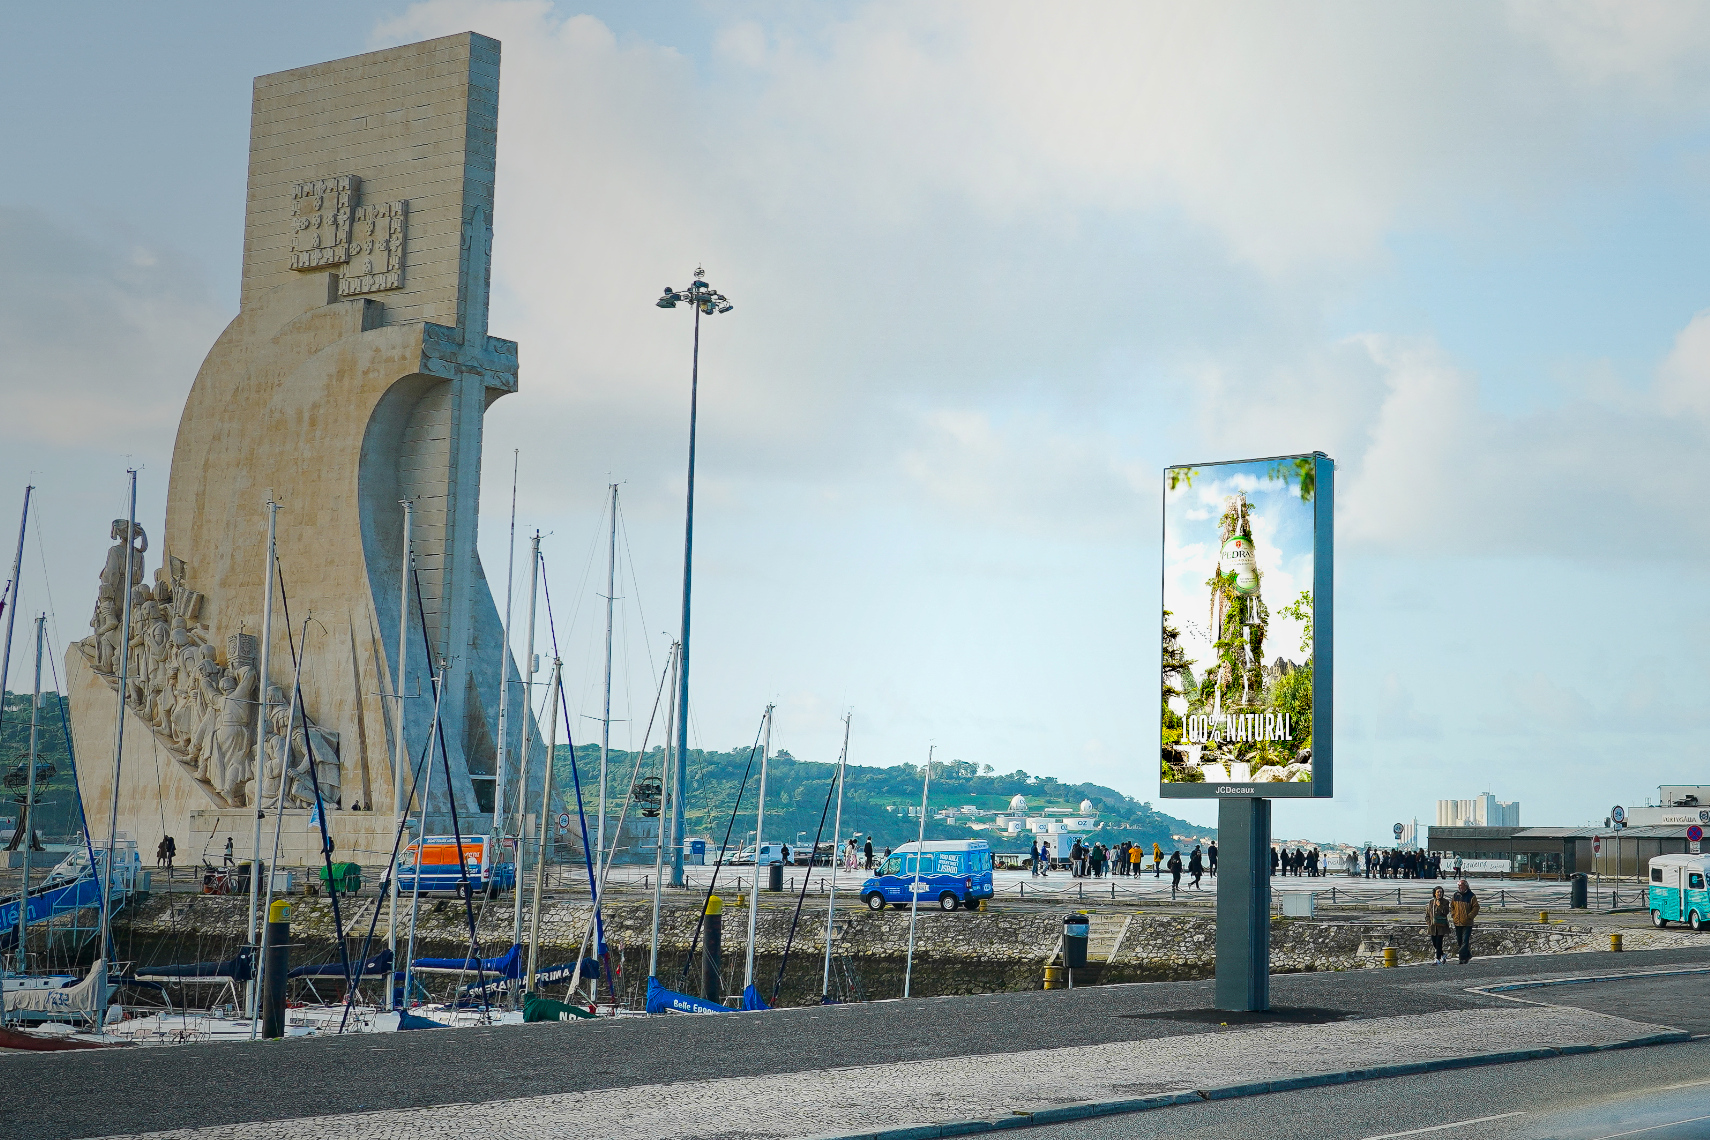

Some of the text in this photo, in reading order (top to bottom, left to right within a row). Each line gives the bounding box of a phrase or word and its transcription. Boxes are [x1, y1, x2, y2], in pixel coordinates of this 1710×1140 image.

[1181, 712, 1293, 743] 100% NATURAL
[1215, 786, 1255, 794] JCDecaux
[534, 967, 570, 983] PRIMA
[673, 999, 691, 1010] Belle
